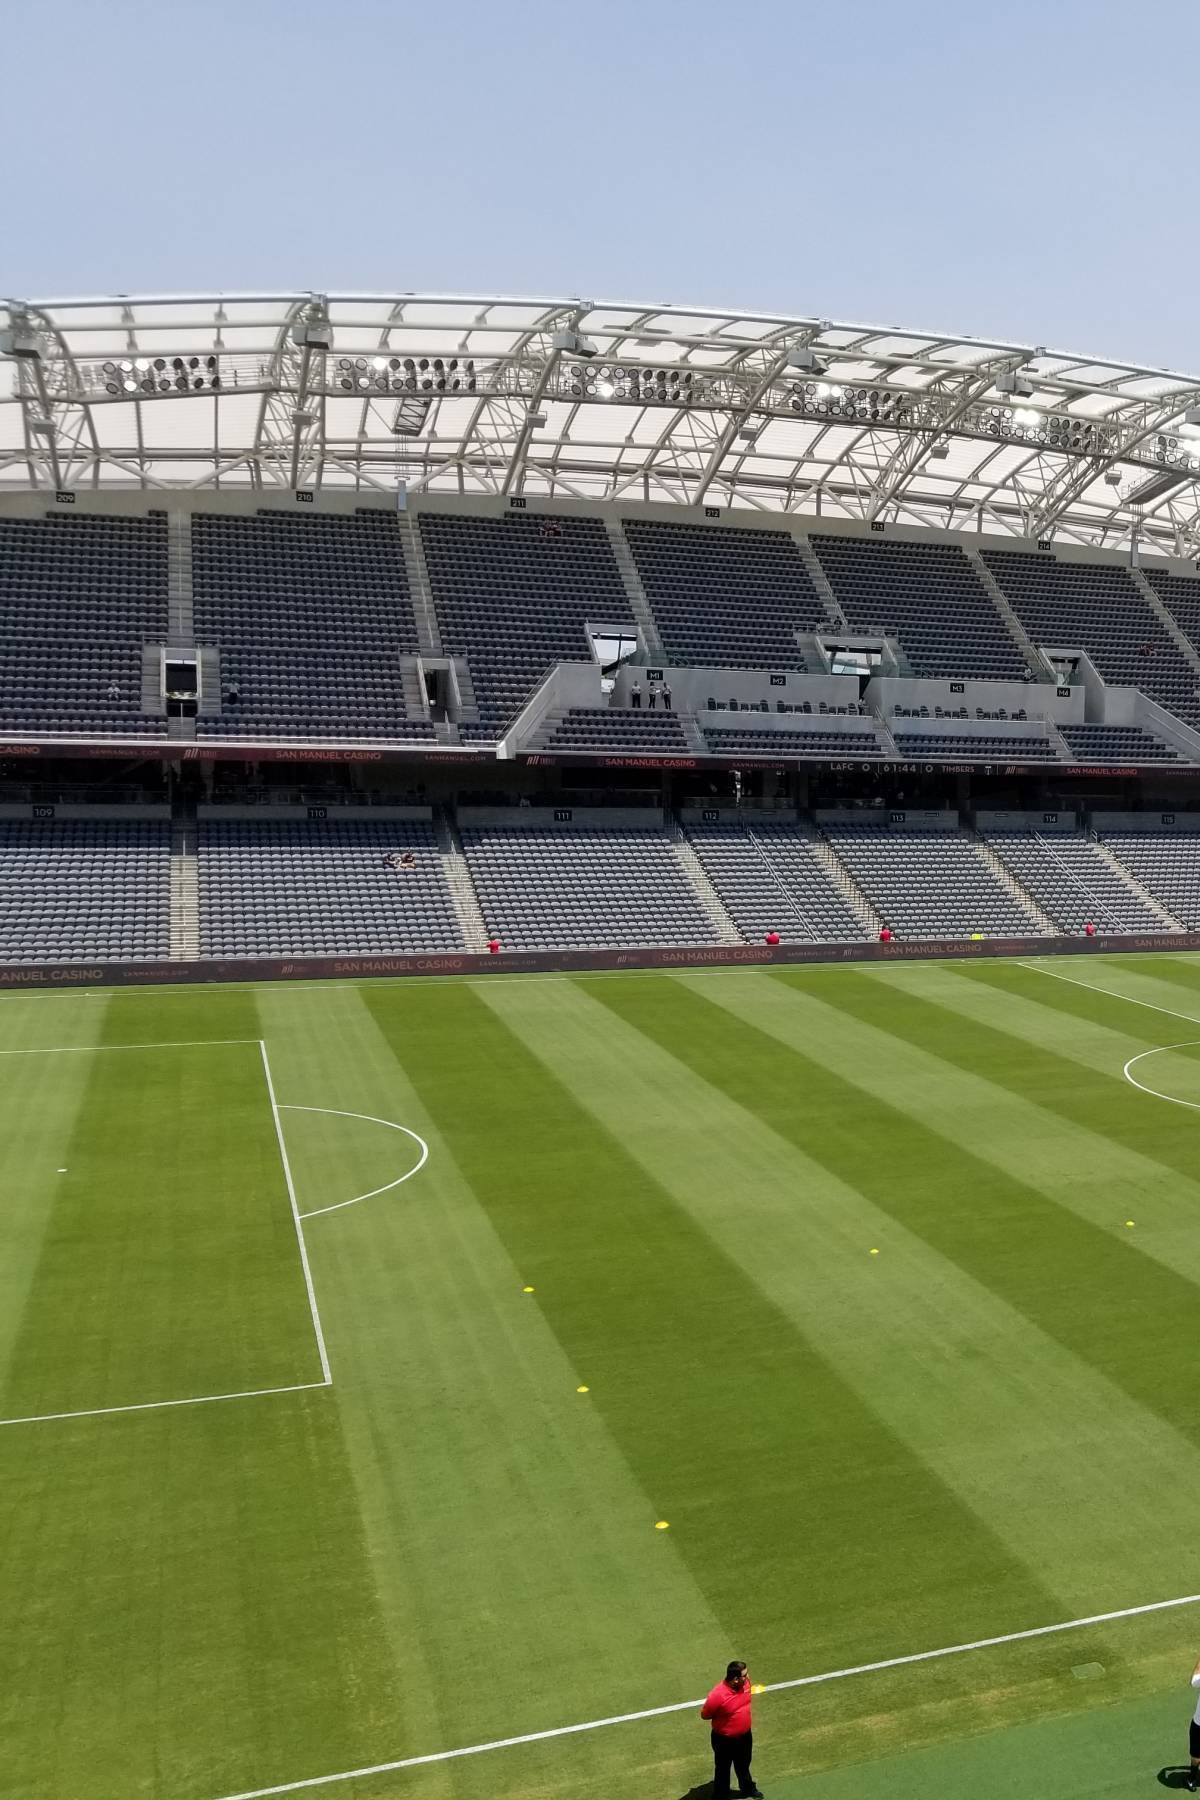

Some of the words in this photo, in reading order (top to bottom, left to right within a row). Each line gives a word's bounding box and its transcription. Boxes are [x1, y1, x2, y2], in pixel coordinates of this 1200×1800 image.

[57, 493, 75, 502] 209
[297, 493, 312, 502] 210
[512, 499, 526, 507] 211
[707, 509, 719, 517] 212
[873, 523, 884, 531] 213
[1039, 541, 1050, 550] 214
[650, 672, 661, 680] M1
[773, 677, 784, 685] M2
[952, 684, 963, 693] M3
[0, 746, 40, 754] CASINO
[276, 751, 297, 760] SAN
[299, 751, 341, 760] MANUEL
[344, 752, 381, 760] CASINO
[605, 758, 624, 766] SAN
[626, 758, 661, 767] MANUEL
[663, 759, 696, 767] CASINO
[830, 762, 854, 771] LAFC
[883, 764, 917, 773] 61:44
[942, 765, 975, 773] TIMBERS
[1067, 767, 1081, 775] SAN
[1082, 767, 1109, 775] MANUEL
[1110, 768, 1137, 776] CASINO
[34, 808, 53, 817] 109
[309, 810, 325, 819] 110
[556, 812, 570, 820] 111
[704, 812, 717, 820] 112
[892, 814, 904, 823] 113
[1045, 815, 1057, 823] 114
[1135, 938, 1151, 947] SAN
[1152, 937, 1188, 946] MANUEL
[883, 946, 903, 955] SAN
[905, 945, 946, 954] MANUEL
[948, 944, 982, 953] CASINO
[663, 951, 684, 961] SAN
[688, 950, 731, 960] MANUEL
[734, 949, 773, 959] CASINO
[334, 961, 360, 972] SAN
[363, 960, 413, 971] MANUEL
[416, 959, 462, 970] CASINO
[0, 971, 48, 982] ANUEL
[50, 969, 103, 980] CASINO
